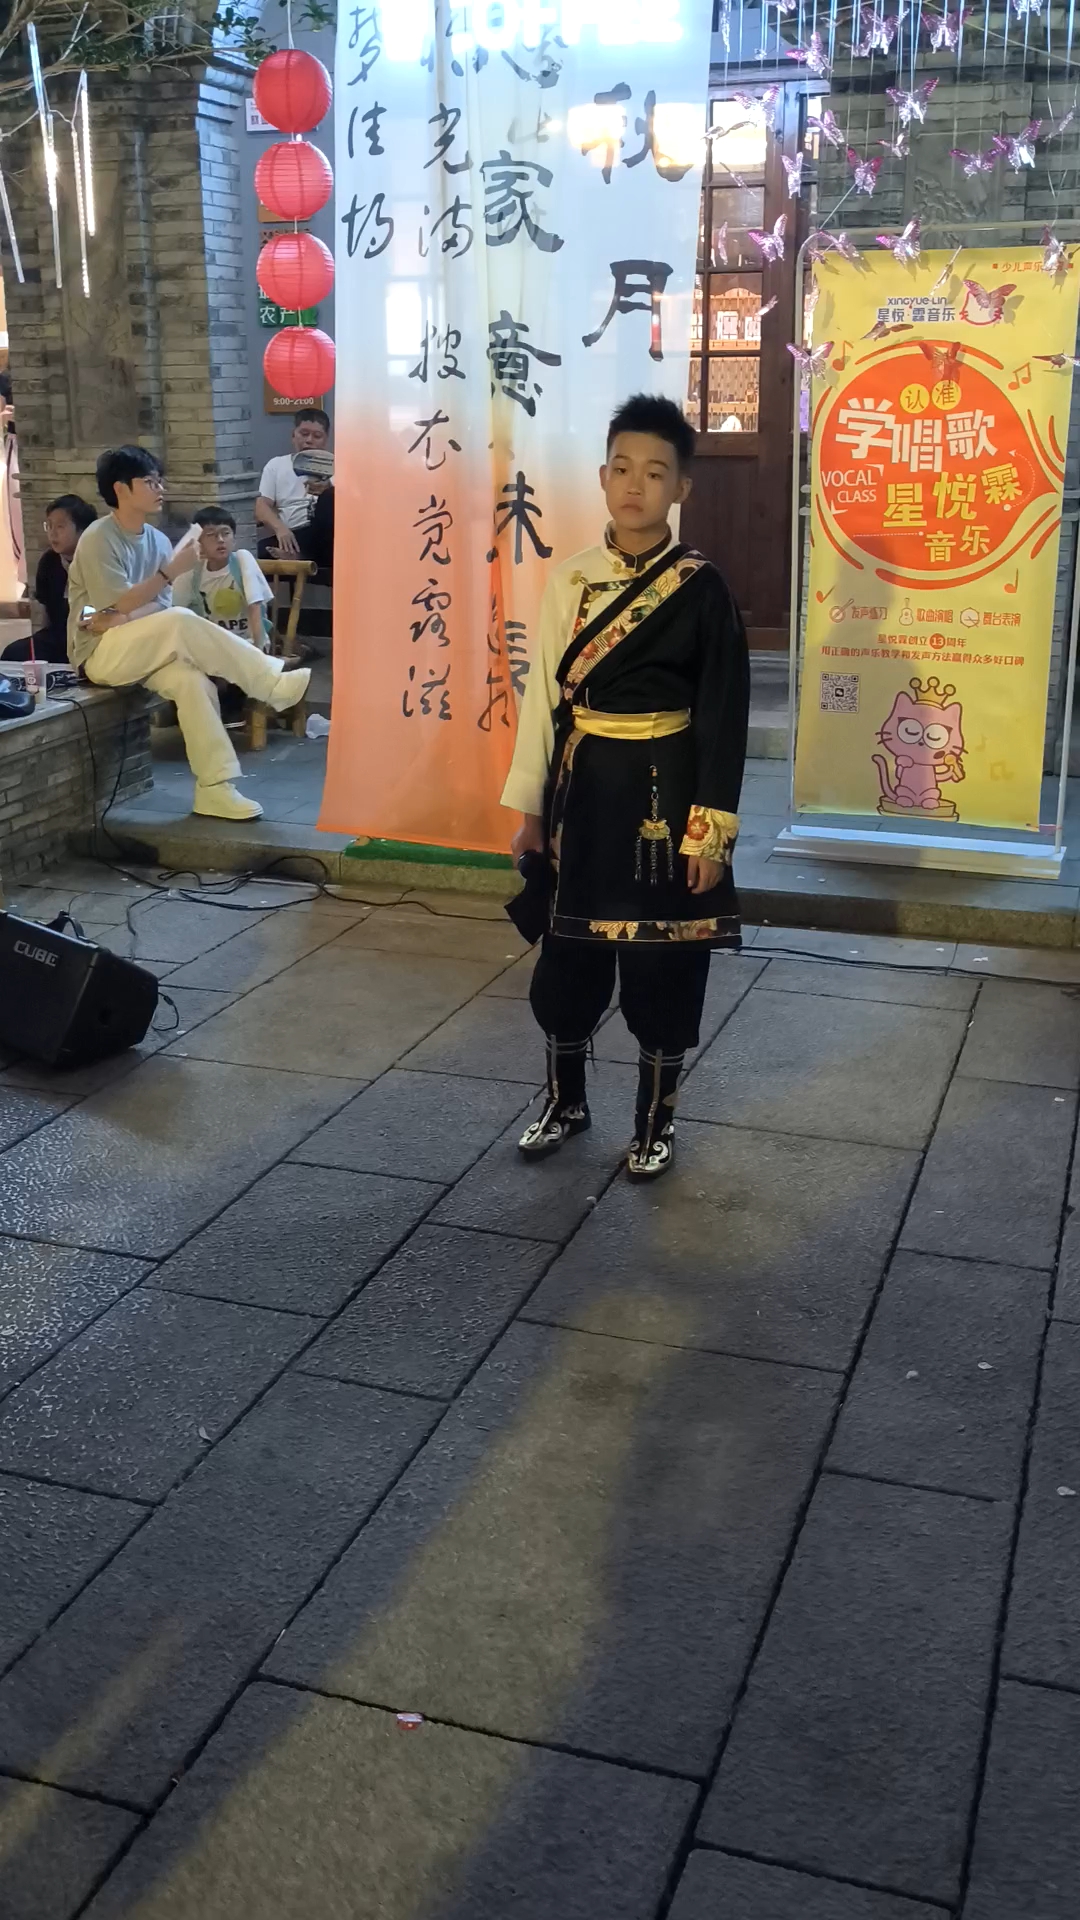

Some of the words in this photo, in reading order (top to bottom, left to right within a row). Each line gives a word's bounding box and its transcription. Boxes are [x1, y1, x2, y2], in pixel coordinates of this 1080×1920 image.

[904, 384, 956, 411] 认准
[835, 397, 998, 473] 学唱歌
[821, 469, 877, 488] VOCAL
[837, 489, 877, 504] CLASS
[882, 462, 1023, 528] 星悦霖
[924, 524, 991, 563] 音乐
[916, 607, 954, 624] 歌曲演唱
[982, 611, 1021, 627] 舞台表演
[13, 940, 59, 967] CUBE
